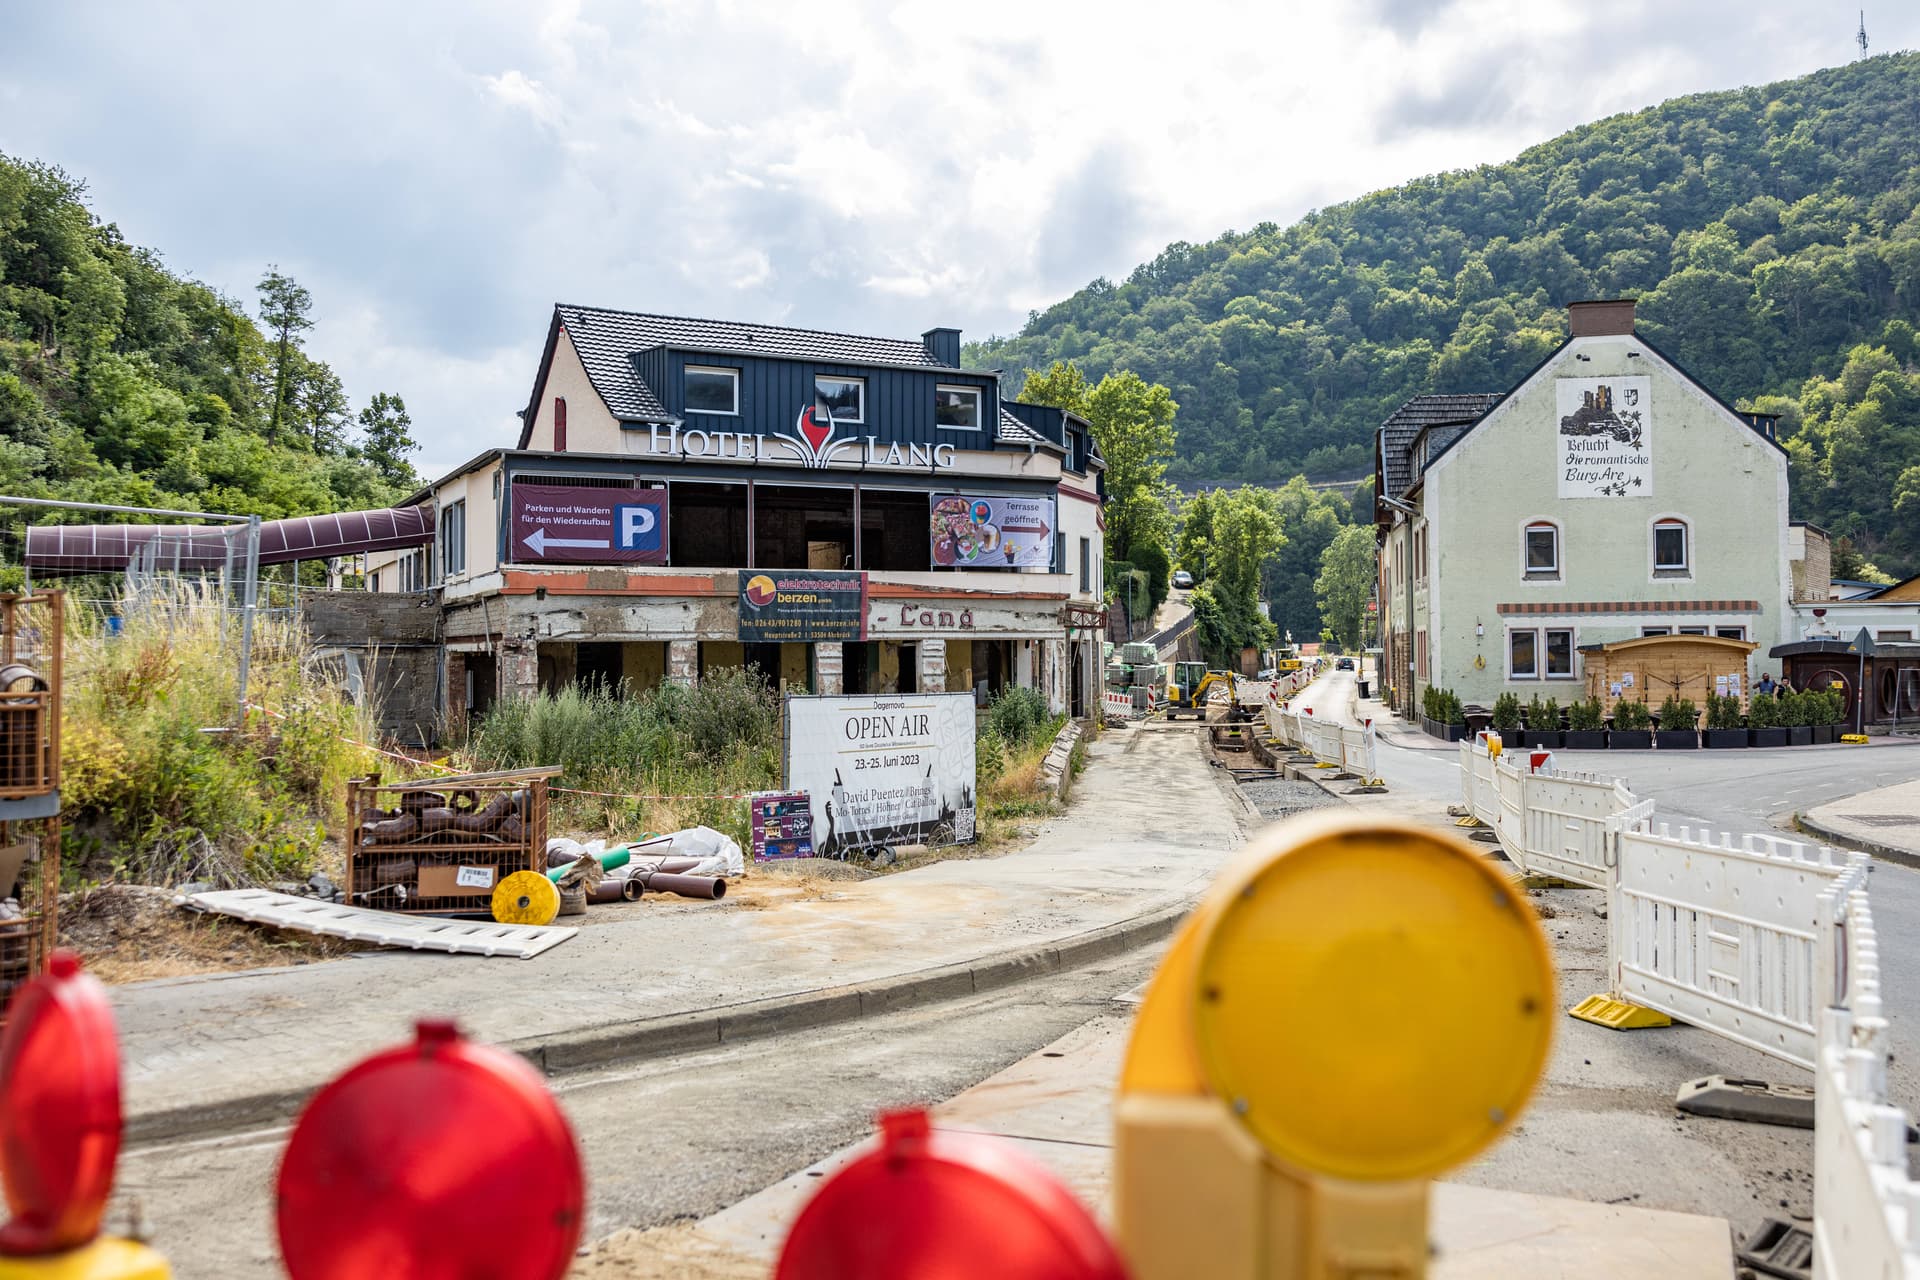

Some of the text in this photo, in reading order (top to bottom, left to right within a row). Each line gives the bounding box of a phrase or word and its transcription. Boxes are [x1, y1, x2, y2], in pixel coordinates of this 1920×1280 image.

[647, 422, 957, 468] HOTEL LANG
[1584, 454, 1649, 465] romantische
[1565, 466, 1625, 484] Burg Are
[525, 503, 611, 515] Parken und Wandern
[1006, 502, 1040, 512] Terrasse
[521, 515, 611, 527] für den Wiederaufbau
[1004, 514, 1040, 525] geöffnet
[622, 507, 655, 547] P
[776, 578, 861, 590] elektrotechnik
[777, 592, 817, 603] berzen
[900, 605, 974, 629] Lang
[873, 701, 905, 711] Dagernova
[845, 714, 930, 740] OPEN AIR
[855, 754, 920, 770] 23.-25. Juni 2023
[842, 789, 869, 804] David
[871, 787, 904, 802] Puentez
[910, 785, 931, 798] Brings
[876, 801, 900, 814] Höhner
